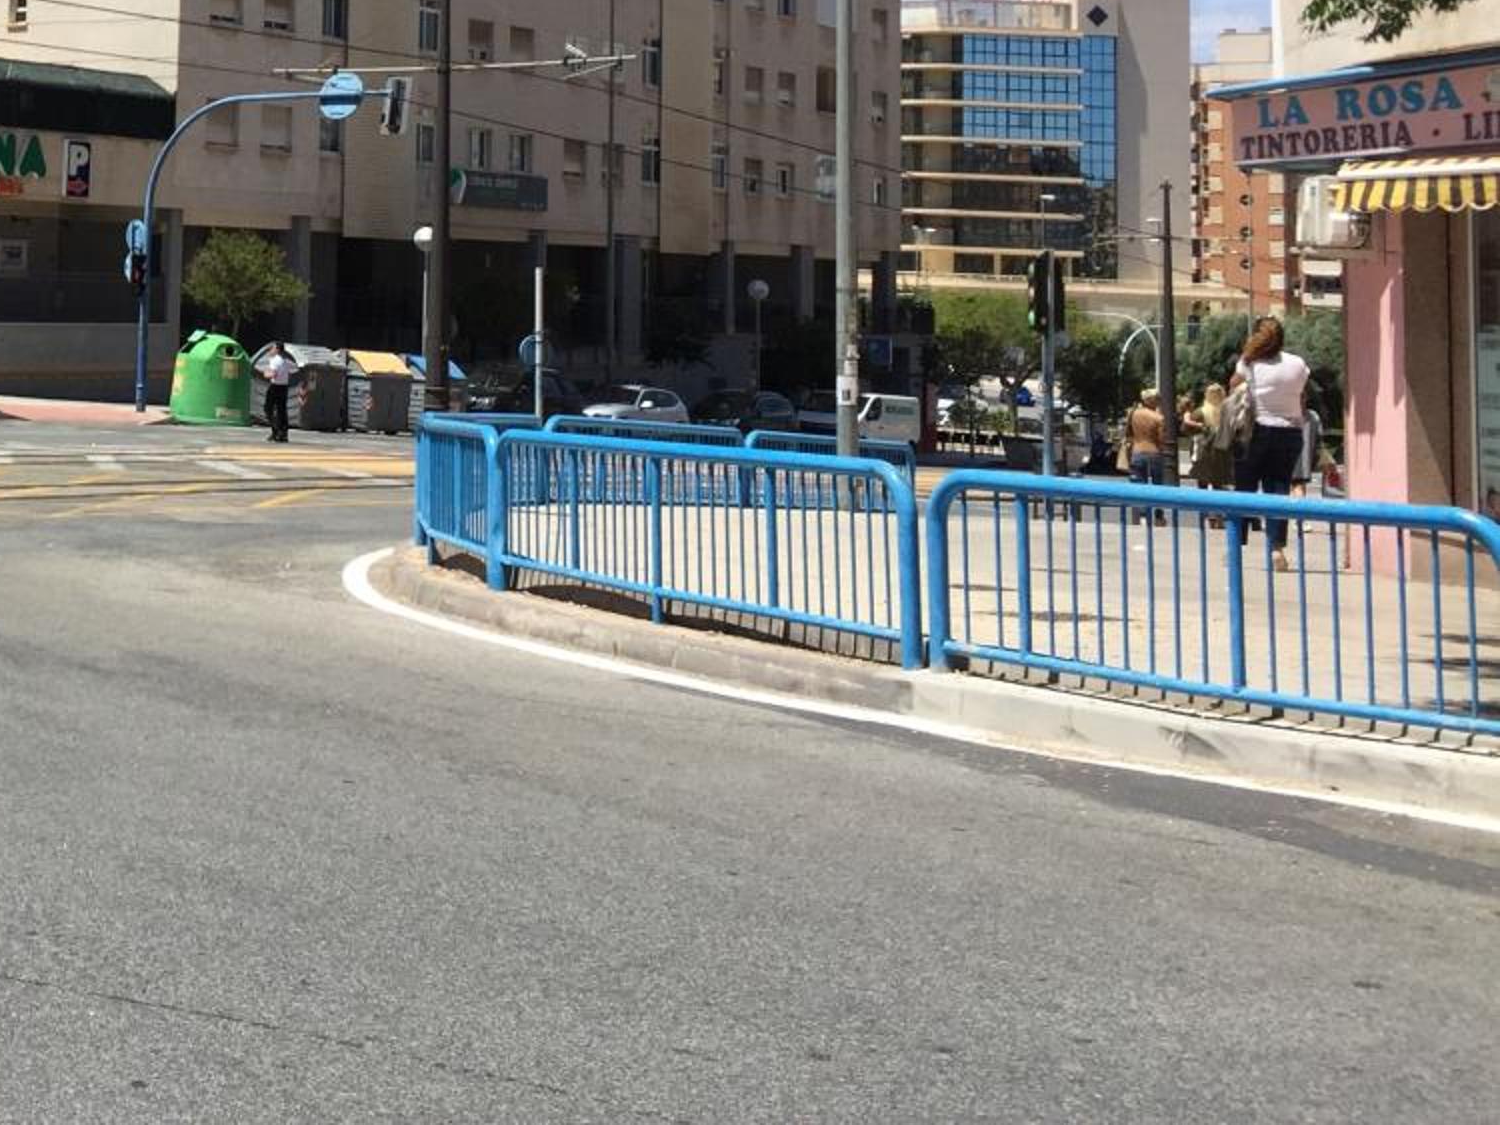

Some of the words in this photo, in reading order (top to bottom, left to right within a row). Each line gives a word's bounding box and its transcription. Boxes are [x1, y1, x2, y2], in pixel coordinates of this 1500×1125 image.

[1256, 94, 1311, 128] LA
[1335, 76, 1464, 122] ROSA
[69, 144, 90, 176] P
[1240, 119, 1415, 161] TINTORERIA
